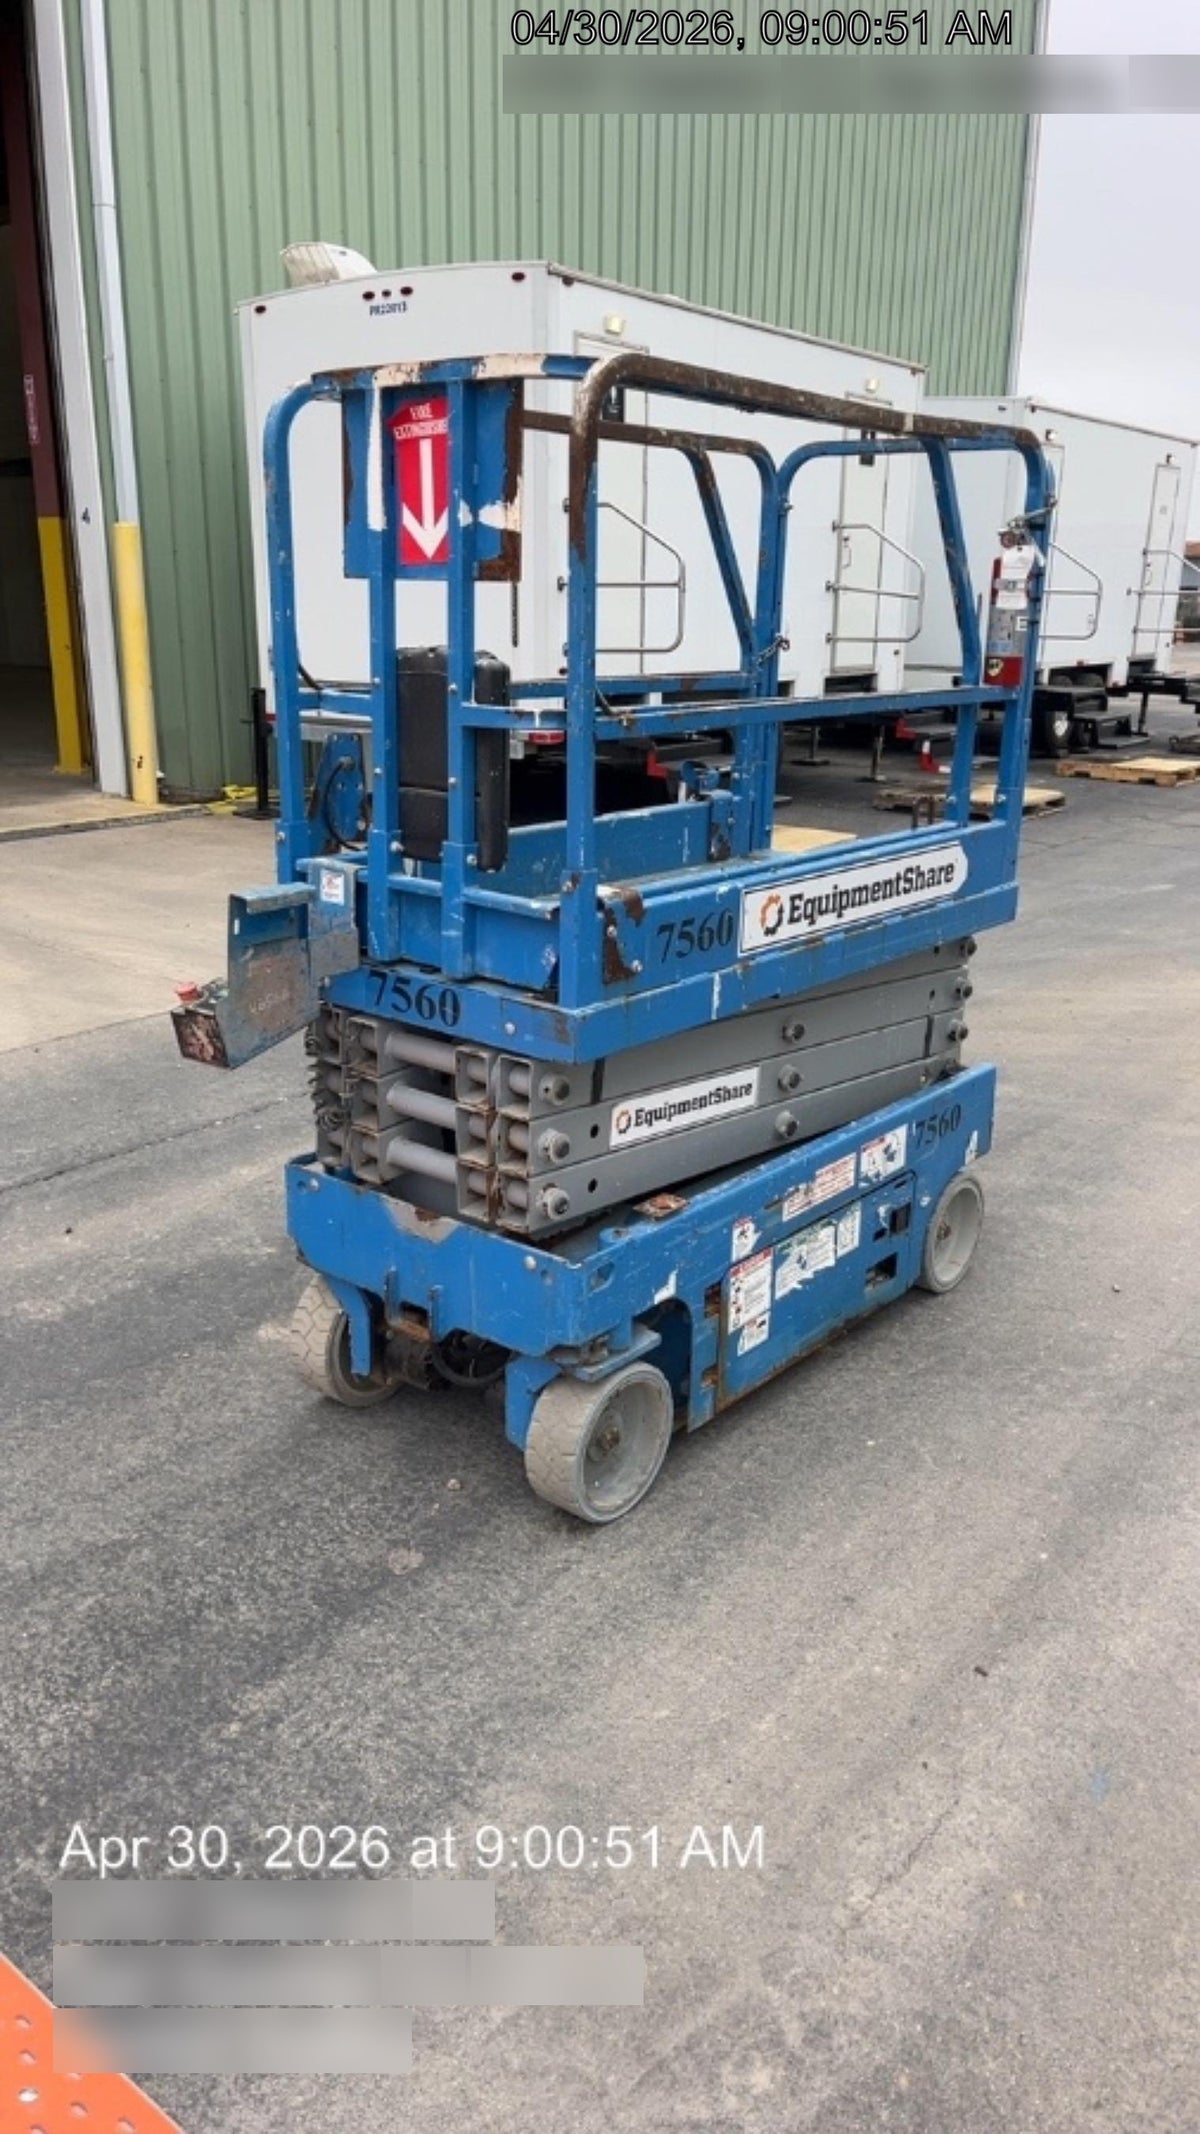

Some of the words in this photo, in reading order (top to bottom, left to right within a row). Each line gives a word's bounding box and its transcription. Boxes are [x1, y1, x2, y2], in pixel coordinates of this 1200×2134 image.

[787, 861, 955, 926] EquipmentShare
[656, 907, 734, 964] 7560
[369, 969, 461, 1027] 7560
[633, 1082, 753, 1127] EquipmentShare
[914, 1103, 963, 1147] 7560
